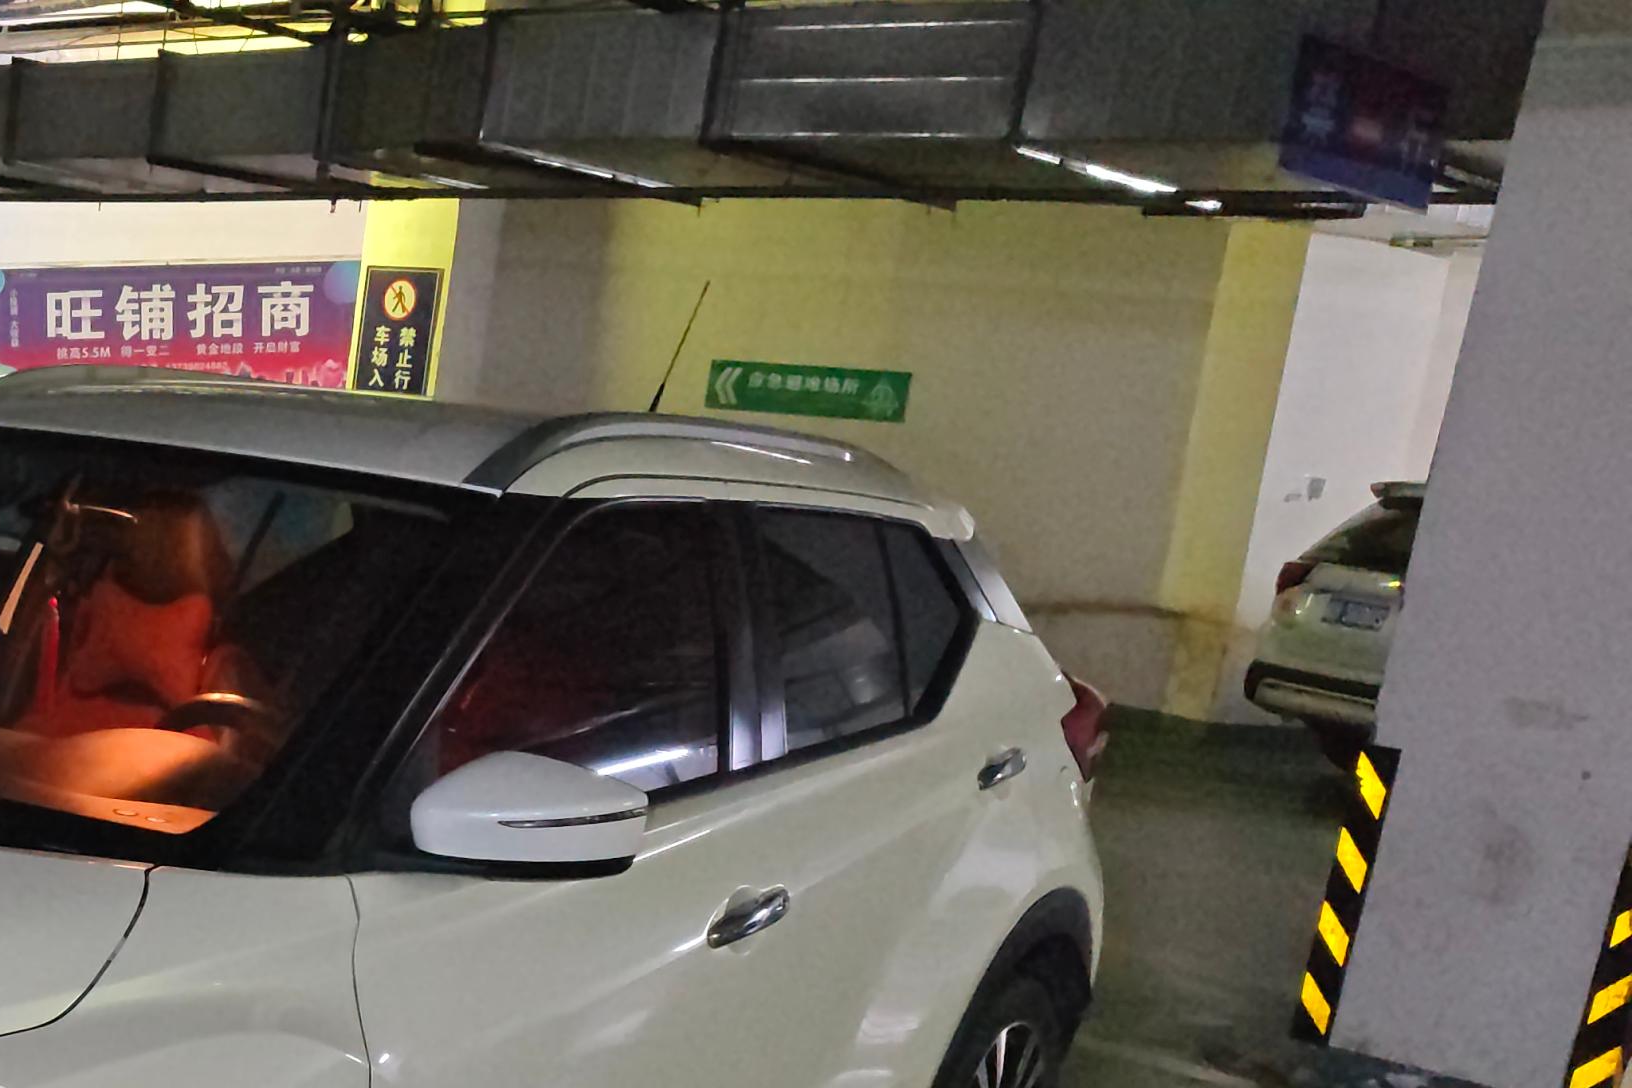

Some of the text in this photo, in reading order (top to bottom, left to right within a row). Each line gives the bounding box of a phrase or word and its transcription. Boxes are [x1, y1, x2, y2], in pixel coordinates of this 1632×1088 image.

[47, 281, 314, 340] 旺铺招商
[196, 342, 244, 356] 黄金地段
[253, 341, 301, 355] 开启财富
[394, 326, 417, 390] 禁止行
